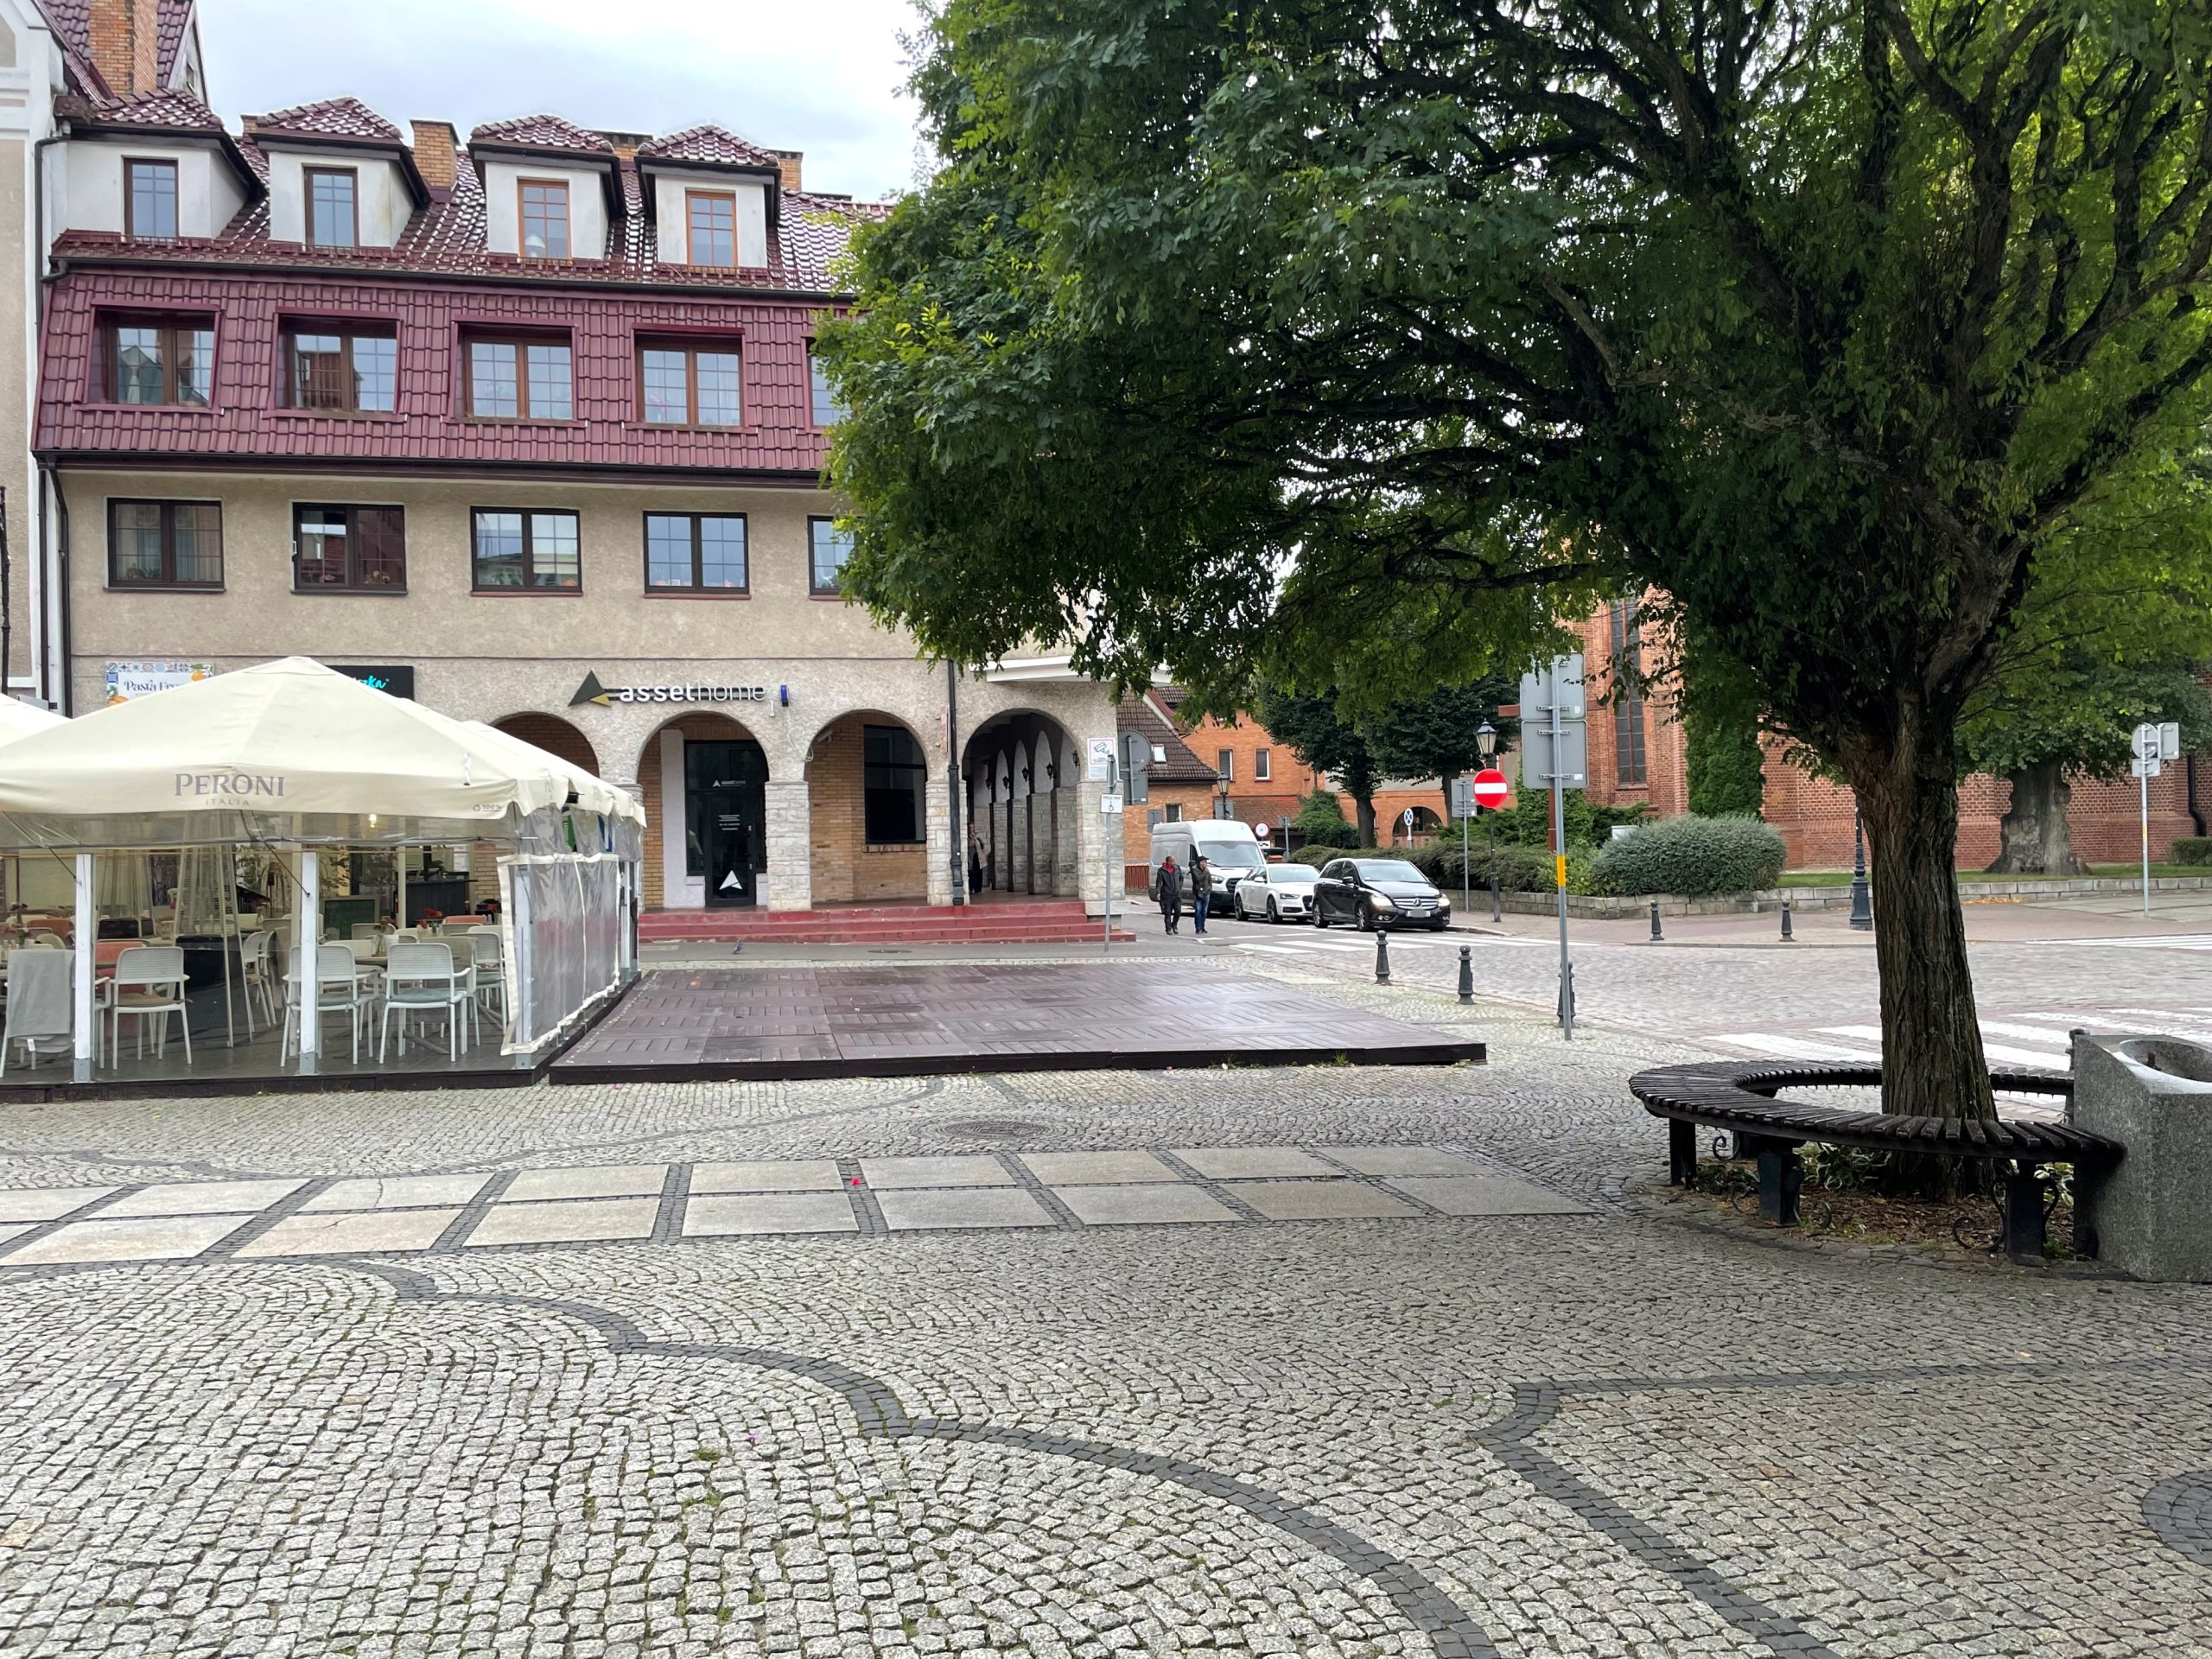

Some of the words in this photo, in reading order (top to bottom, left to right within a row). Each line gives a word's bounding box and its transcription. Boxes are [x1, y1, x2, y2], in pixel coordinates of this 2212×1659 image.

[619, 682, 766, 702] assethome
[175, 773, 285, 797] PERONI
[206, 798, 250, 806] ITALIA
